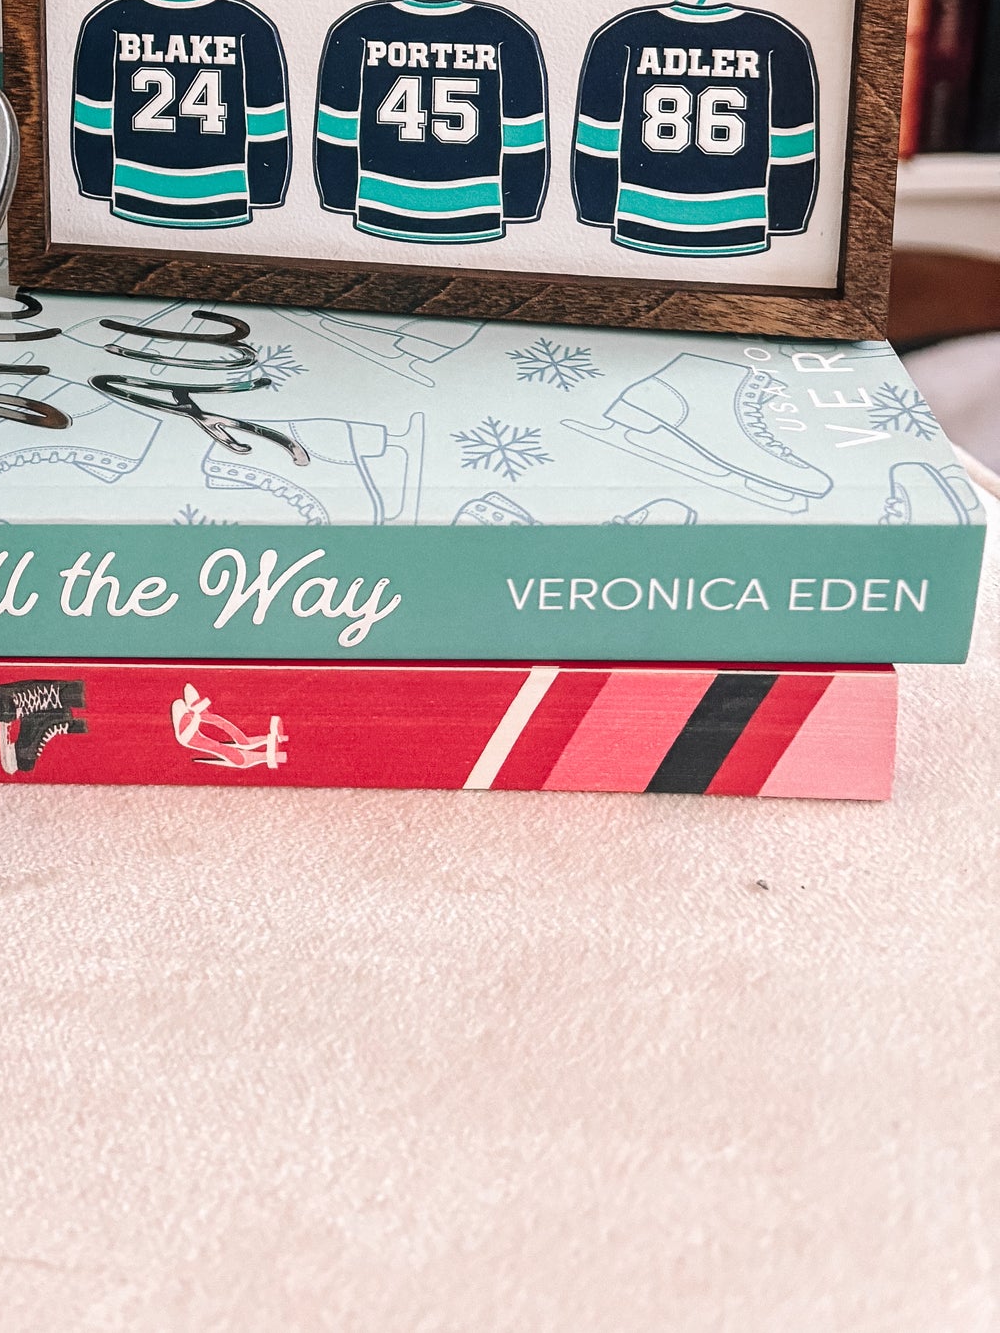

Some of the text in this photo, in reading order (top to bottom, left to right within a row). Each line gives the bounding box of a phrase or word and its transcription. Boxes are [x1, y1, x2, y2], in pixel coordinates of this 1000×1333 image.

[118, 32, 237, 66] BLAKE
[366, 40, 498, 70] PORTER
[636, 47, 761, 79] ADLER
[131, 66, 228, 136] 24
[376, 76, 480, 145] 45
[641, 83, 748, 156] 86
[761, 385, 807, 432] USA
[59, 551, 179, 616] the
[199, 548, 402, 648] Way
[506, 577, 930, 613] VERONICA EDEN
